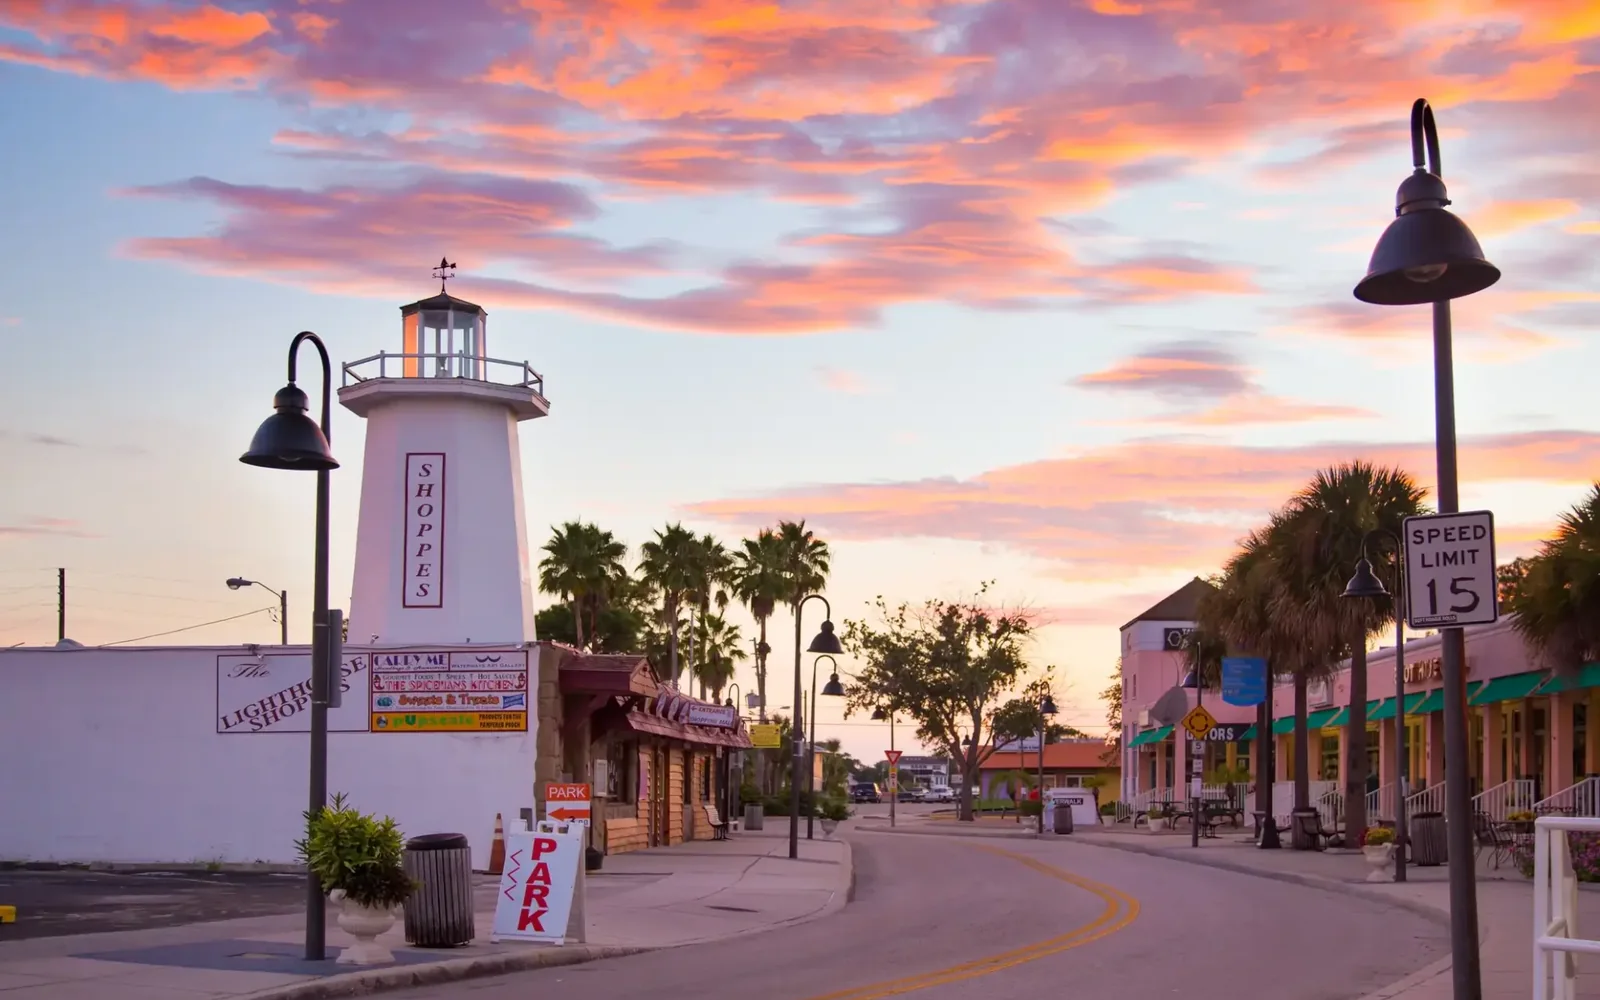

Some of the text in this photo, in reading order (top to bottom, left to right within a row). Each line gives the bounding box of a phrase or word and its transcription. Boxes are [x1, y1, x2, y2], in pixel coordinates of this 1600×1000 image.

[415, 463, 435, 597] SHOPPES
[1412, 524, 1487, 545] SPEED
[1421, 549, 1479, 568] LIMIT
[1426, 577, 1480, 615] 15
[227, 663, 271, 678] The
[220, 656, 367, 730] LIGHTHSE
[385, 680, 406, 690] THE
[471, 679, 514, 690] KITCHEN
[249, 679, 350, 731] SHOPS
[1186, 727, 1234, 740] GORS
[549, 787, 586, 798] PARK
[517, 837, 557, 932] PARK
